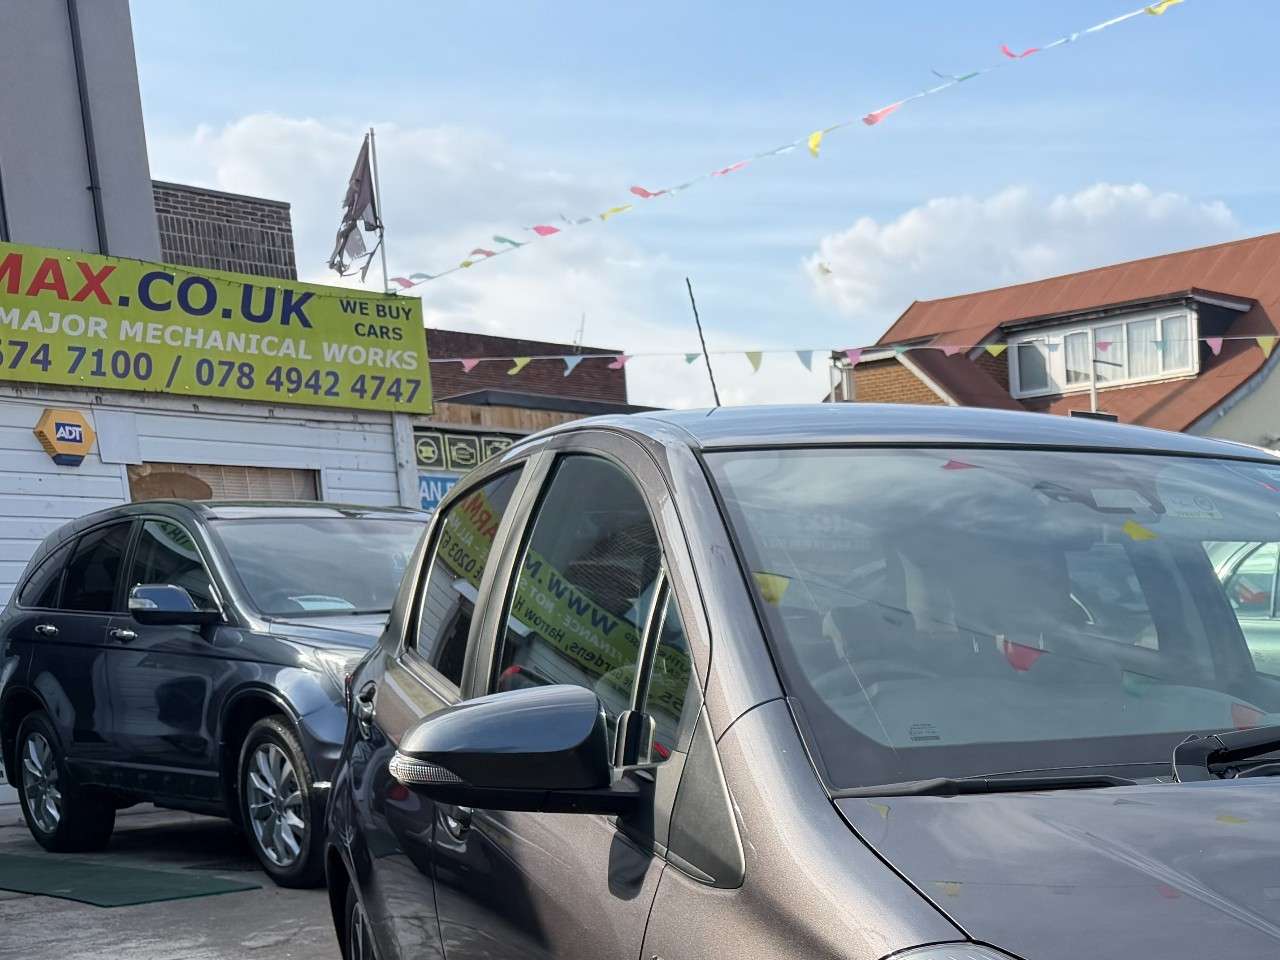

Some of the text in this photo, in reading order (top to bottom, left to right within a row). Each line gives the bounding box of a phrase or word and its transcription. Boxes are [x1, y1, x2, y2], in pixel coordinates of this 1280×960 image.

[340, 299, 412, 321] WE BUY
[0, 306, 418, 370] MAJOR MECHANICAL WORKS
[354, 322, 403, 341] CARS
[0, 338, 421, 404] 74 7100 / 078 4942 4747
[56, 425, 82, 441] ADT
